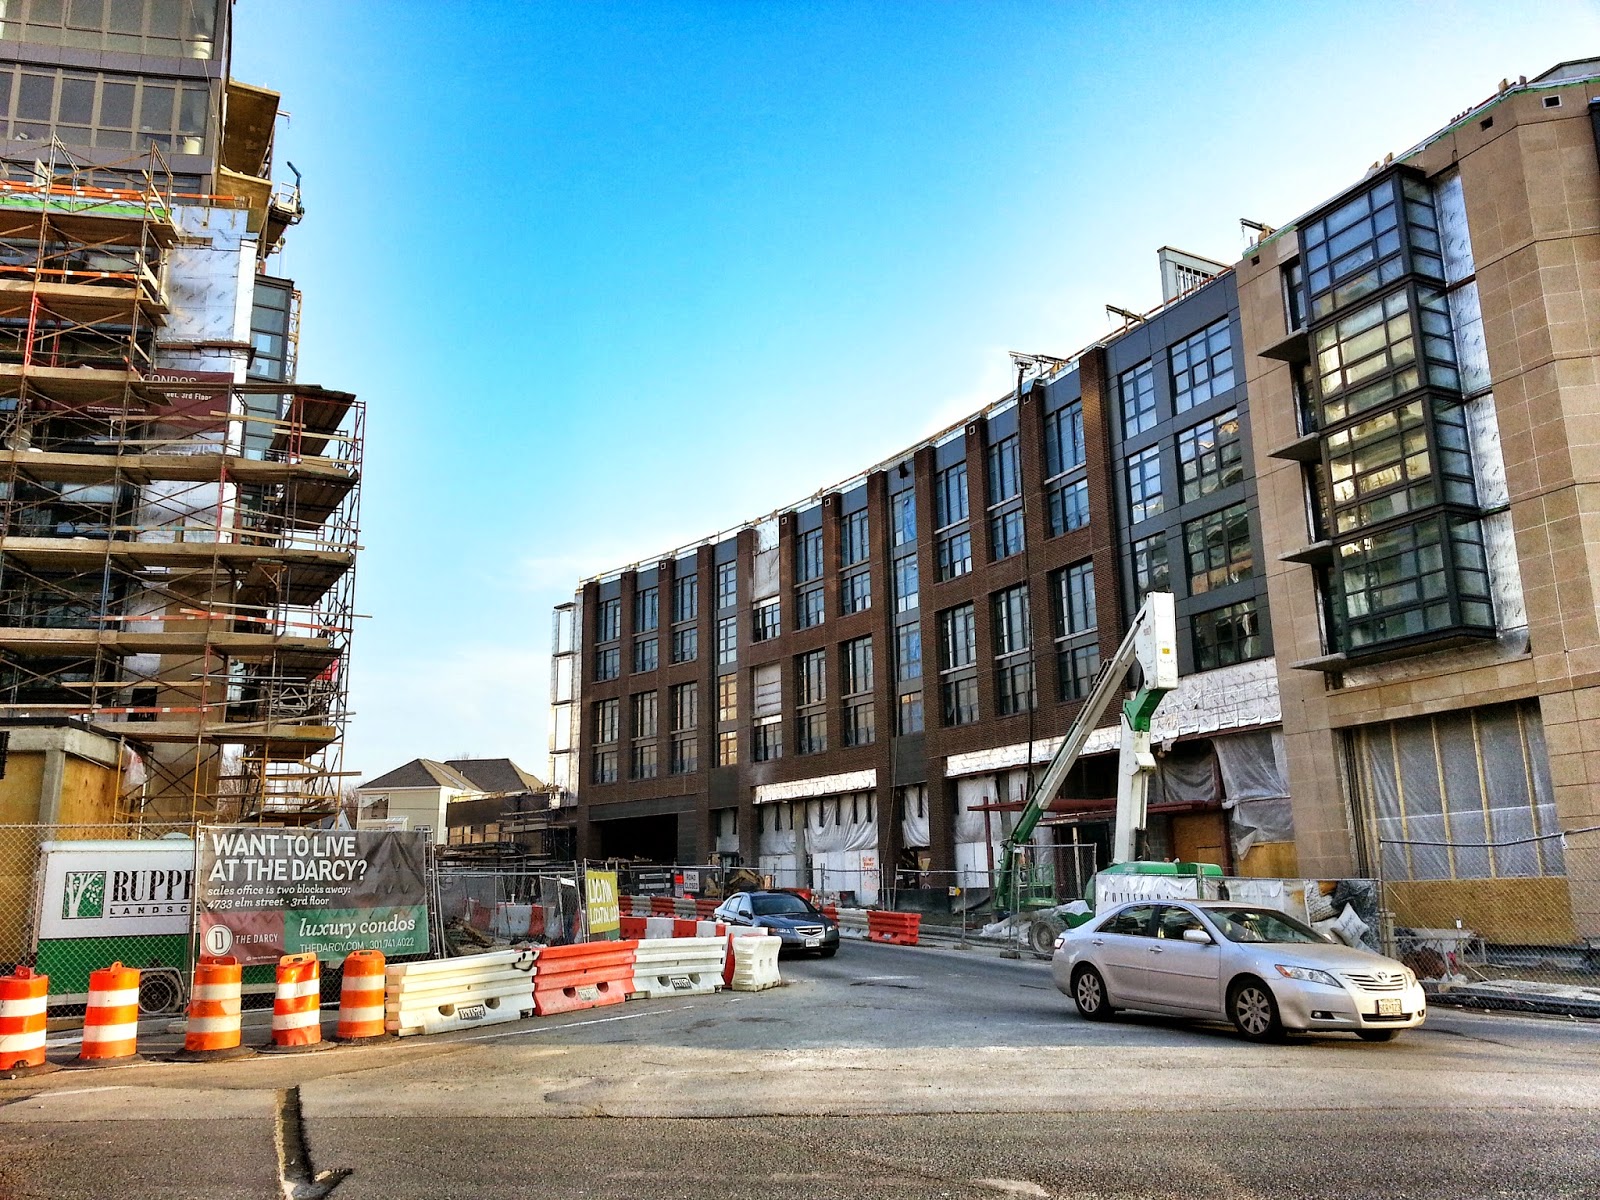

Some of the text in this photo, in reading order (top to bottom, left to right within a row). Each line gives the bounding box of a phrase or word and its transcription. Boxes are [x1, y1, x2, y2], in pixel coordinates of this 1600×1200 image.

[212, 833, 356, 857] WANT TO LIVE
[208, 859, 368, 882] AT THE DARCY?
[111, 870, 195, 902] RUPPE
[207, 884, 352, 896] sales office is two blocks away:
[207, 895, 330, 910] 4733 elm street 3rd floor
[299, 914, 416, 939] luxury condos
[235, 933, 279, 944] THE DARCY
[299, 937, 415, 953] THEDARCY.COM 301.741.4022
